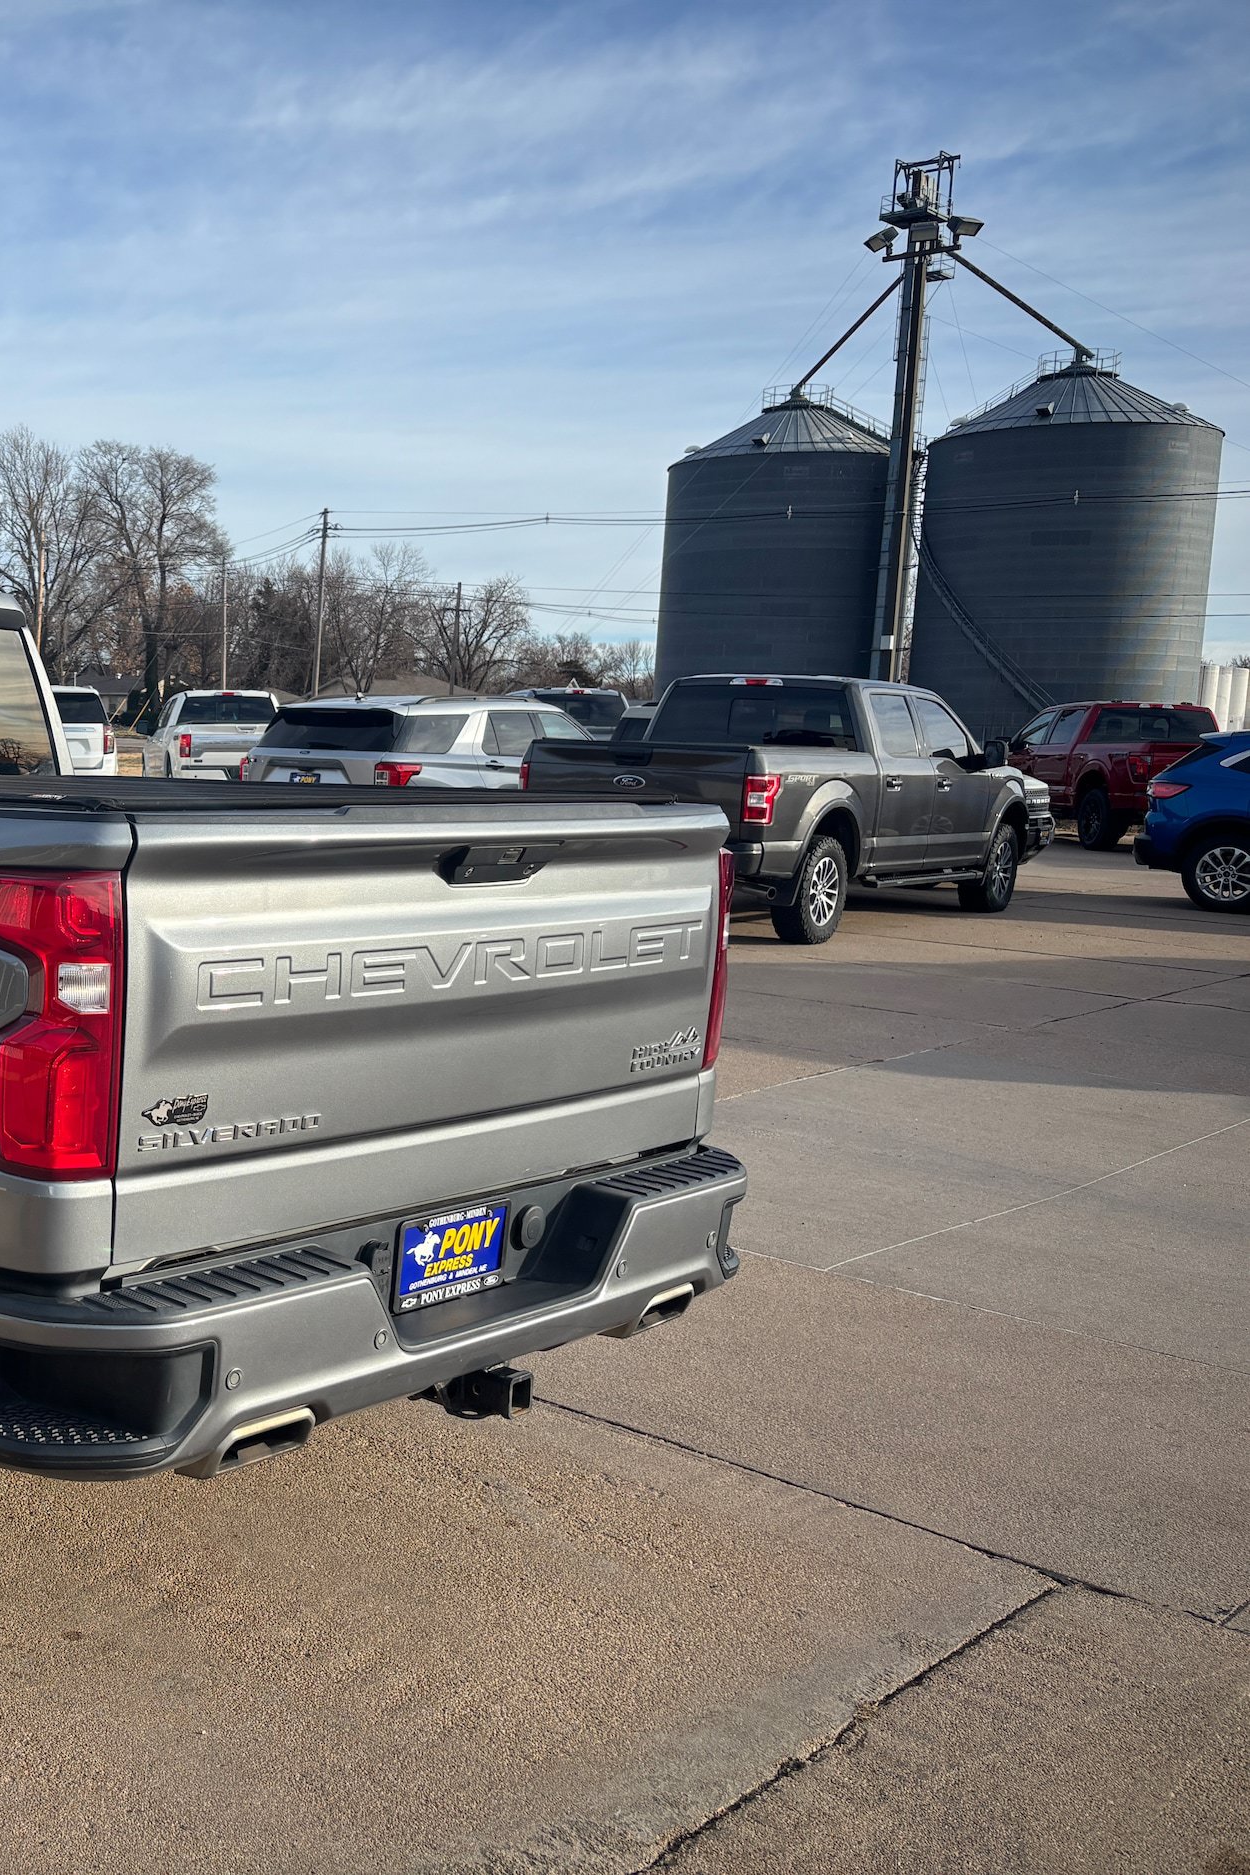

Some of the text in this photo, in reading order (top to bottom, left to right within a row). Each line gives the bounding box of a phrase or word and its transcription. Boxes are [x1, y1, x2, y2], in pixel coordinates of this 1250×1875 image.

[196, 919, 703, 1012] CHEVROLET
[630, 1047, 701, 1073] COUNTRY
[137, 1113, 322, 1152] SILVERADO
[438, 1217, 501, 1259] PONY
[408, 1274, 447, 1291] GOTHENBURG
[479, 1264, 488, 1272] NE
[423, 1253, 474, 1278] EXPRESS
[420, 1288, 445, 1305] PONY
[445, 1278, 481, 1298] EXPRESS
